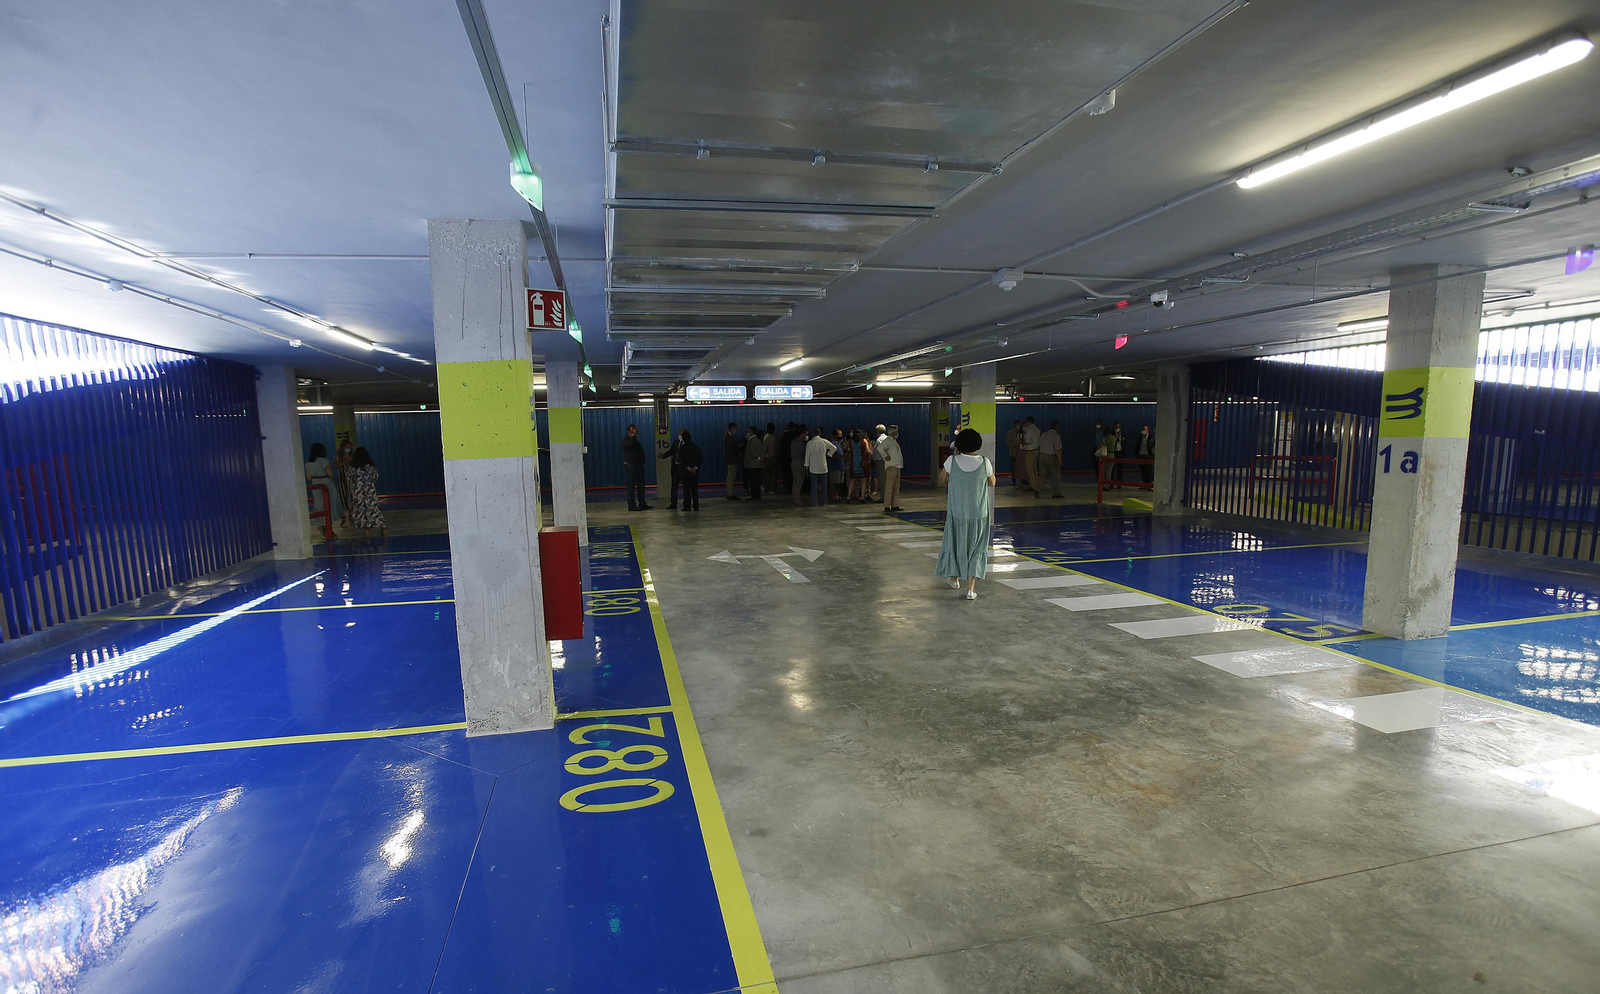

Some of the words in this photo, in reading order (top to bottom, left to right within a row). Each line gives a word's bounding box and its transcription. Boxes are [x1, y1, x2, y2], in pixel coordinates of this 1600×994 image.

[760, 387, 789, 395] SALIDA
[656, 439, 670, 449] 1b
[584, 590, 642, 616] 081
[1212, 604, 1358, 637] 075
[559, 716, 675, 814] 082
